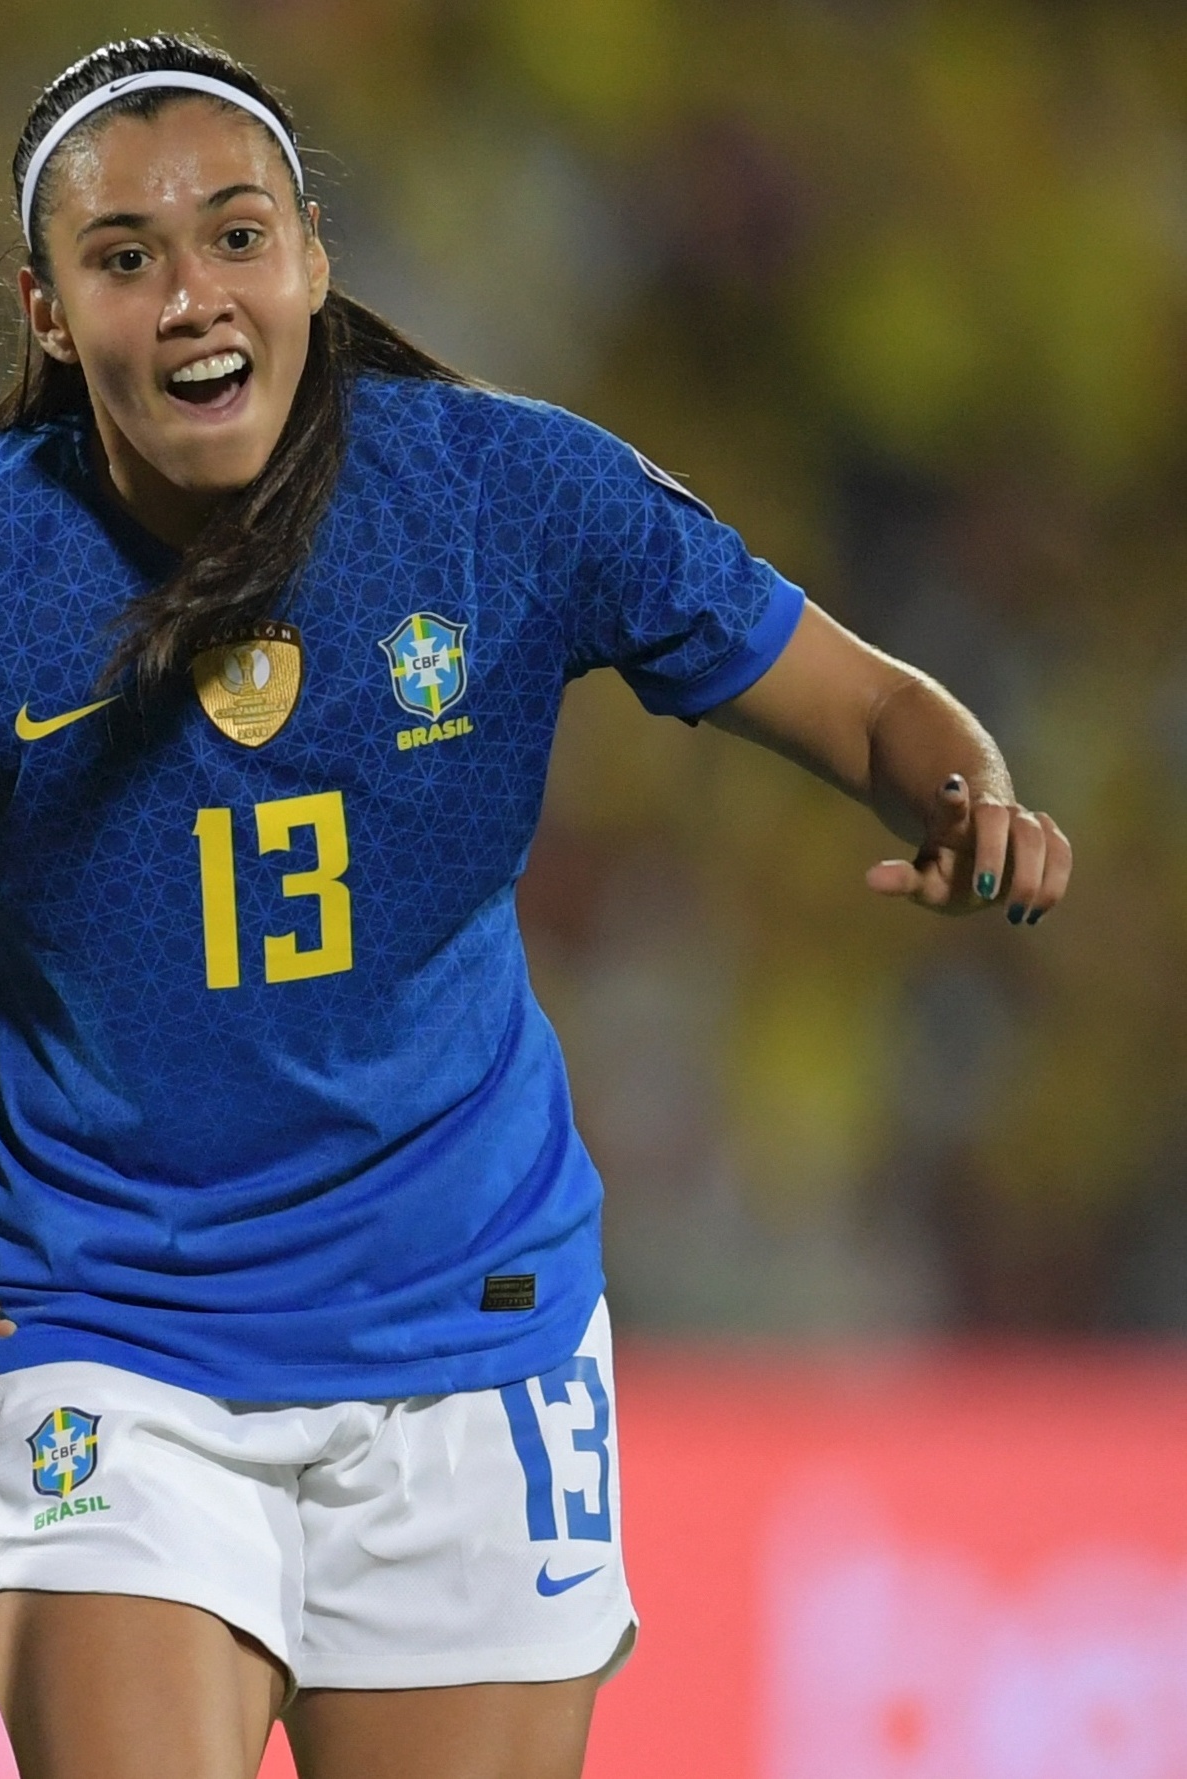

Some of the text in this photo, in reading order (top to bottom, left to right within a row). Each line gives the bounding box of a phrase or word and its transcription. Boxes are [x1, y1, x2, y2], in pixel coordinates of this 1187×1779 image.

[412, 654, 440, 670] CBF
[397, 716, 473, 751] BRASIL
[192, 791, 352, 989] 13
[51, 1443, 77, 1461] CBF
[500, 1355, 611, 1542] 13
[33, 1495, 111, 1531] BRASIL
